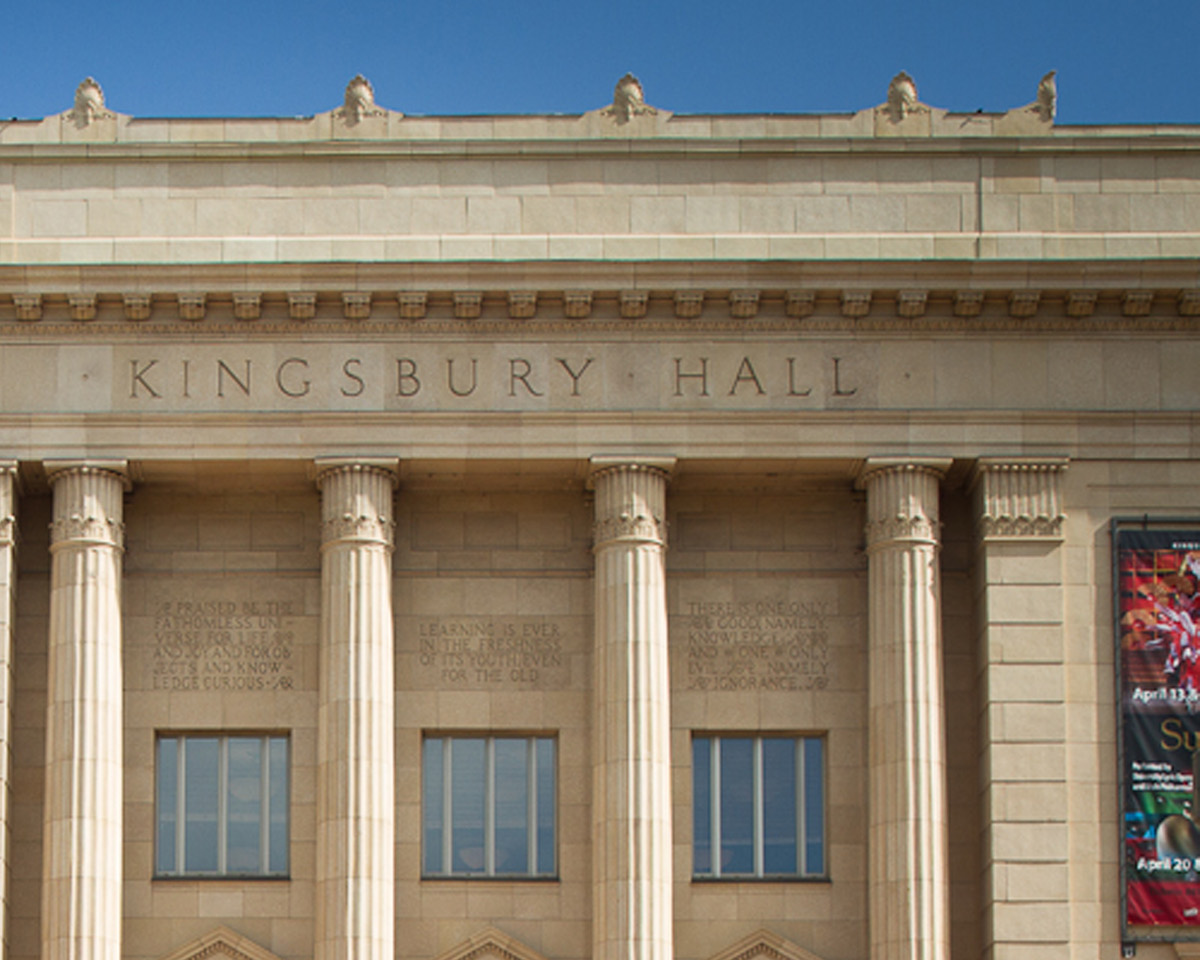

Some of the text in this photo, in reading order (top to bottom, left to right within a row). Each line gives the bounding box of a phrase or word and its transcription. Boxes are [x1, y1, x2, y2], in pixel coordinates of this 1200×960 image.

[129, 356, 858, 398] KINGSBURY HALL
[687, 602, 735, 616] THERE
[755, 602, 786, 616] ONE
[789, 602, 829, 616] ONLY
[419, 623, 560, 637] LEARNING IS EVER
[419, 638, 562, 652] IN THE FRESHNESS
[211, 646, 243, 660] AND
[419, 653, 438, 667] OF
[442, 653, 464, 666] ITS
[522, 653, 562, 667] EVEN
[689, 646, 829, 660] AND ONE ONLY
[204, 661, 232, 675] AND
[441, 669, 540, 682] FOR THE OLD
[153, 676, 200, 690] LEDGE
[1133, 687, 1167, 704] April
[1137, 857, 1171, 873] April
[1174, 857, 1192, 871] 20
